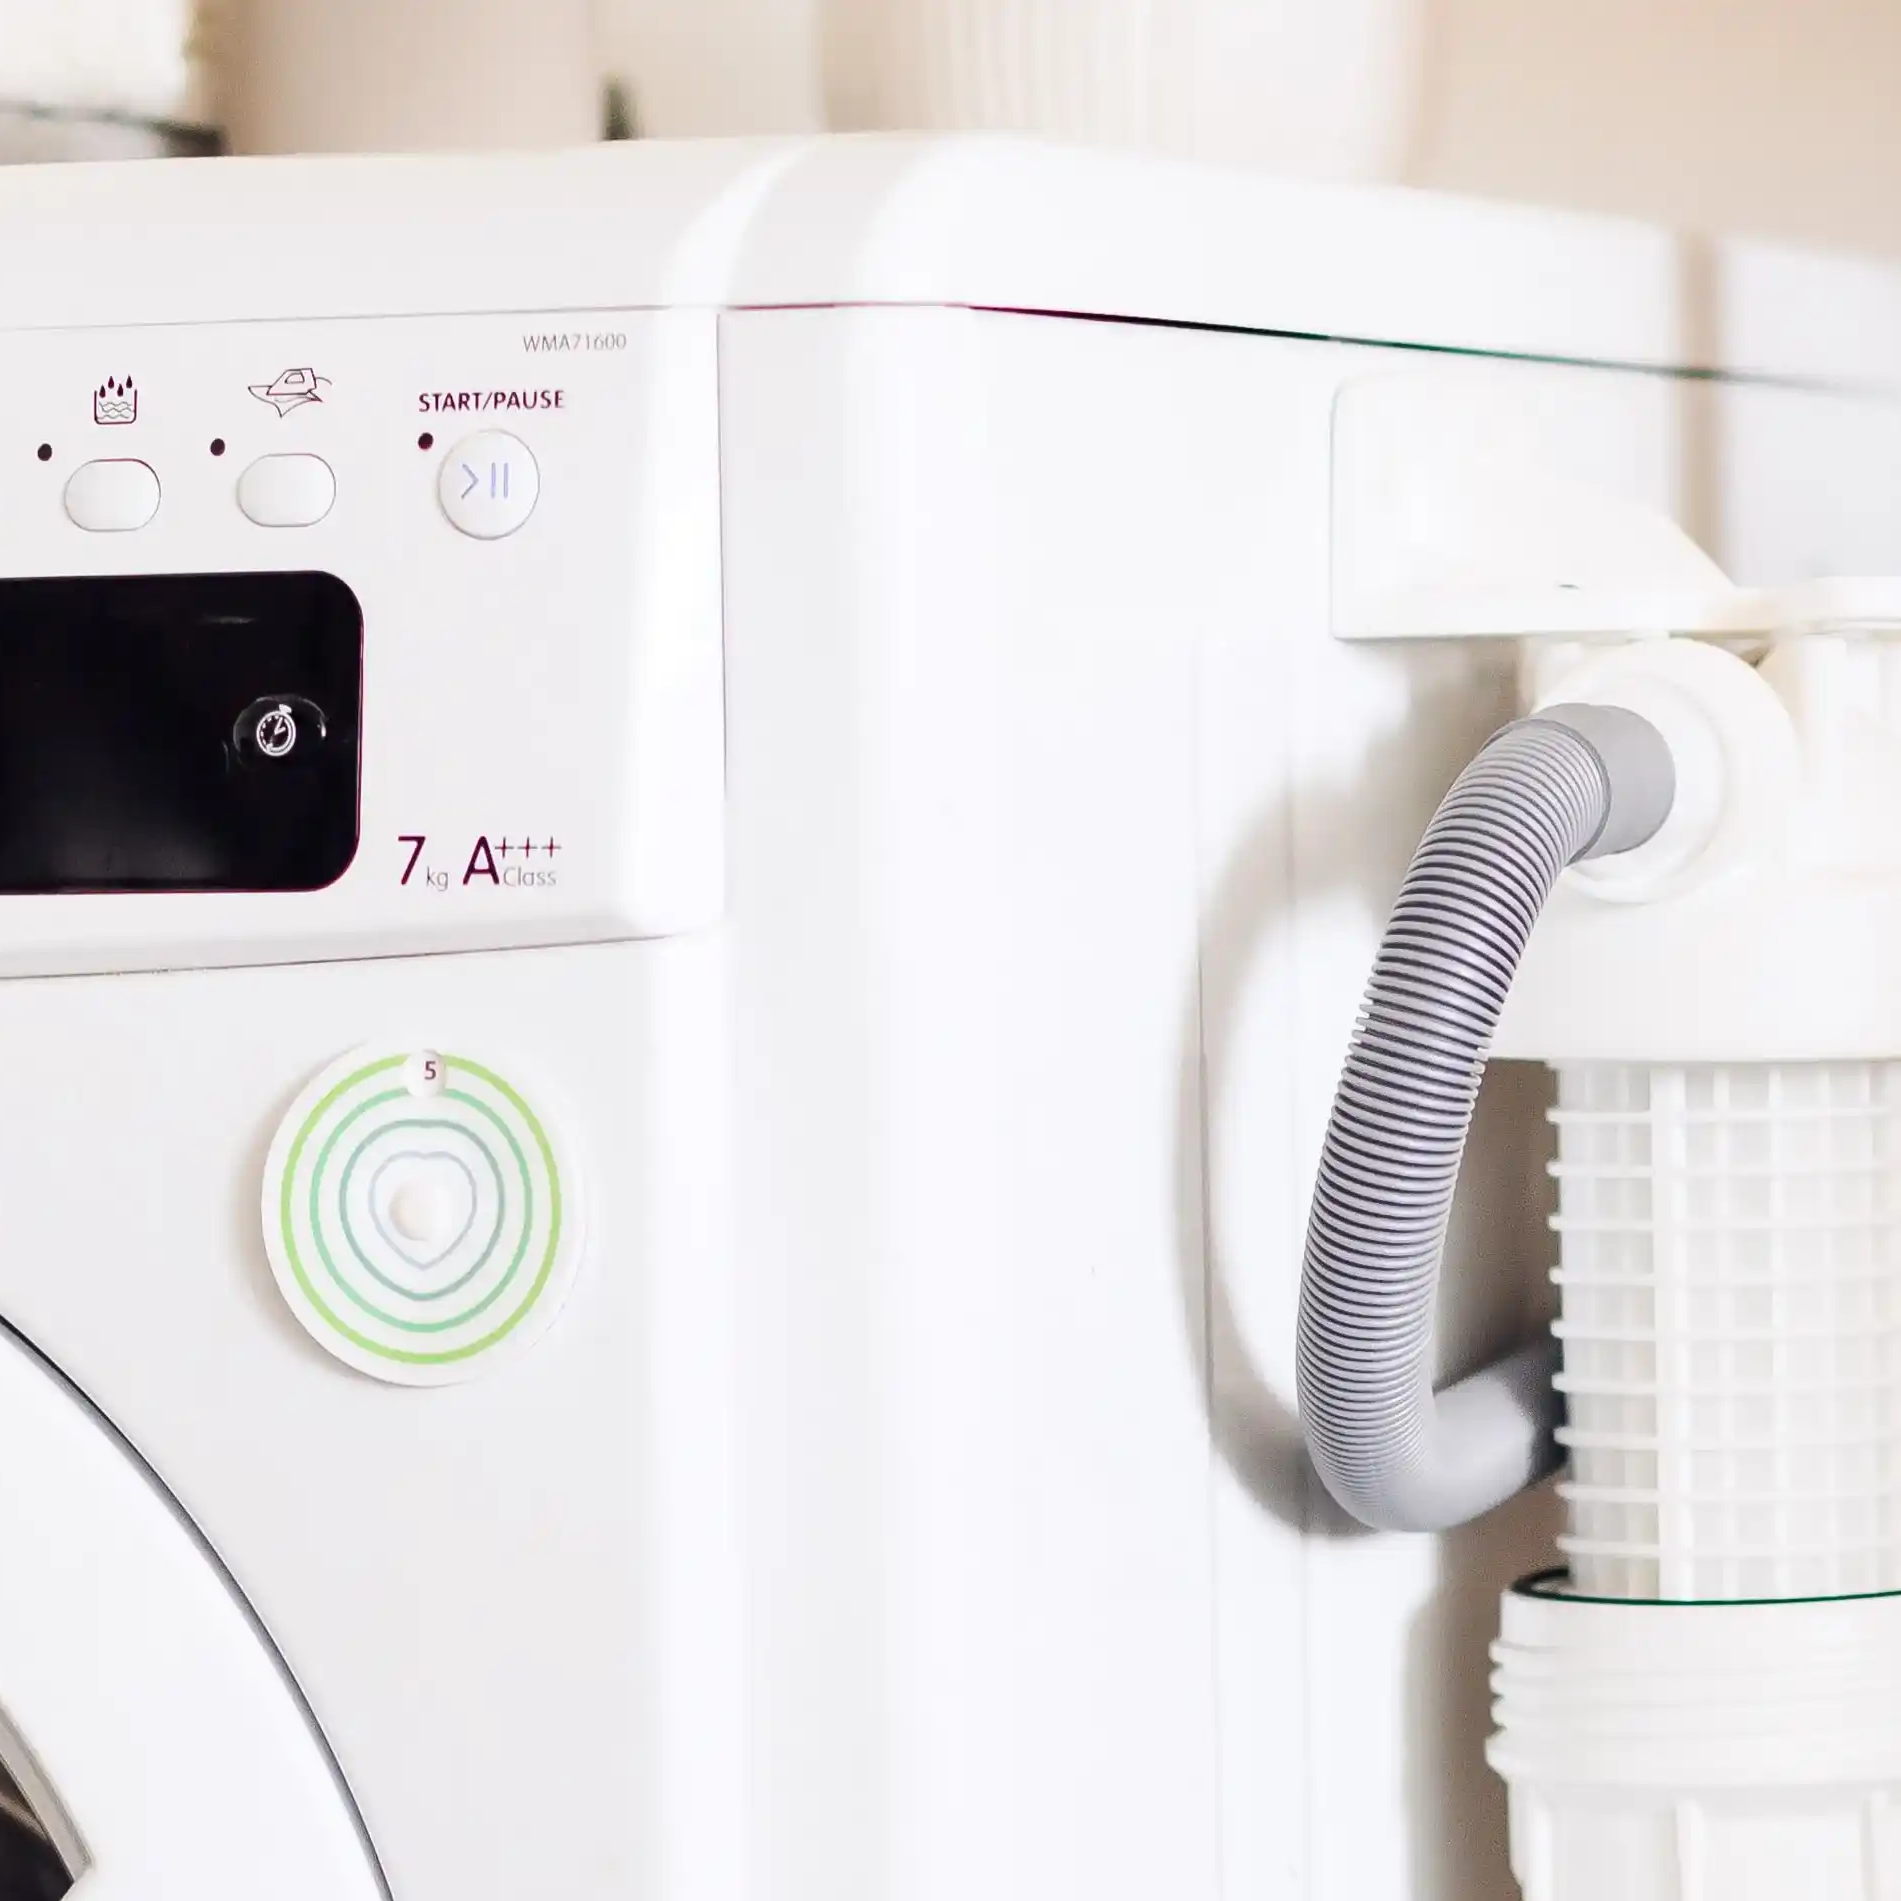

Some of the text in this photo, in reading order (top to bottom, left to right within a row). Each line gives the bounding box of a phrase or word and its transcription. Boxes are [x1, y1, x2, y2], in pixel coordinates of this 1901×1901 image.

[419, 390, 563, 412] START/PAUSE
[398, 836, 426, 885] 7
[427, 868, 448, 888] kg
[503, 867, 556, 886] Class
[424, 1060, 437, 1080] 5
